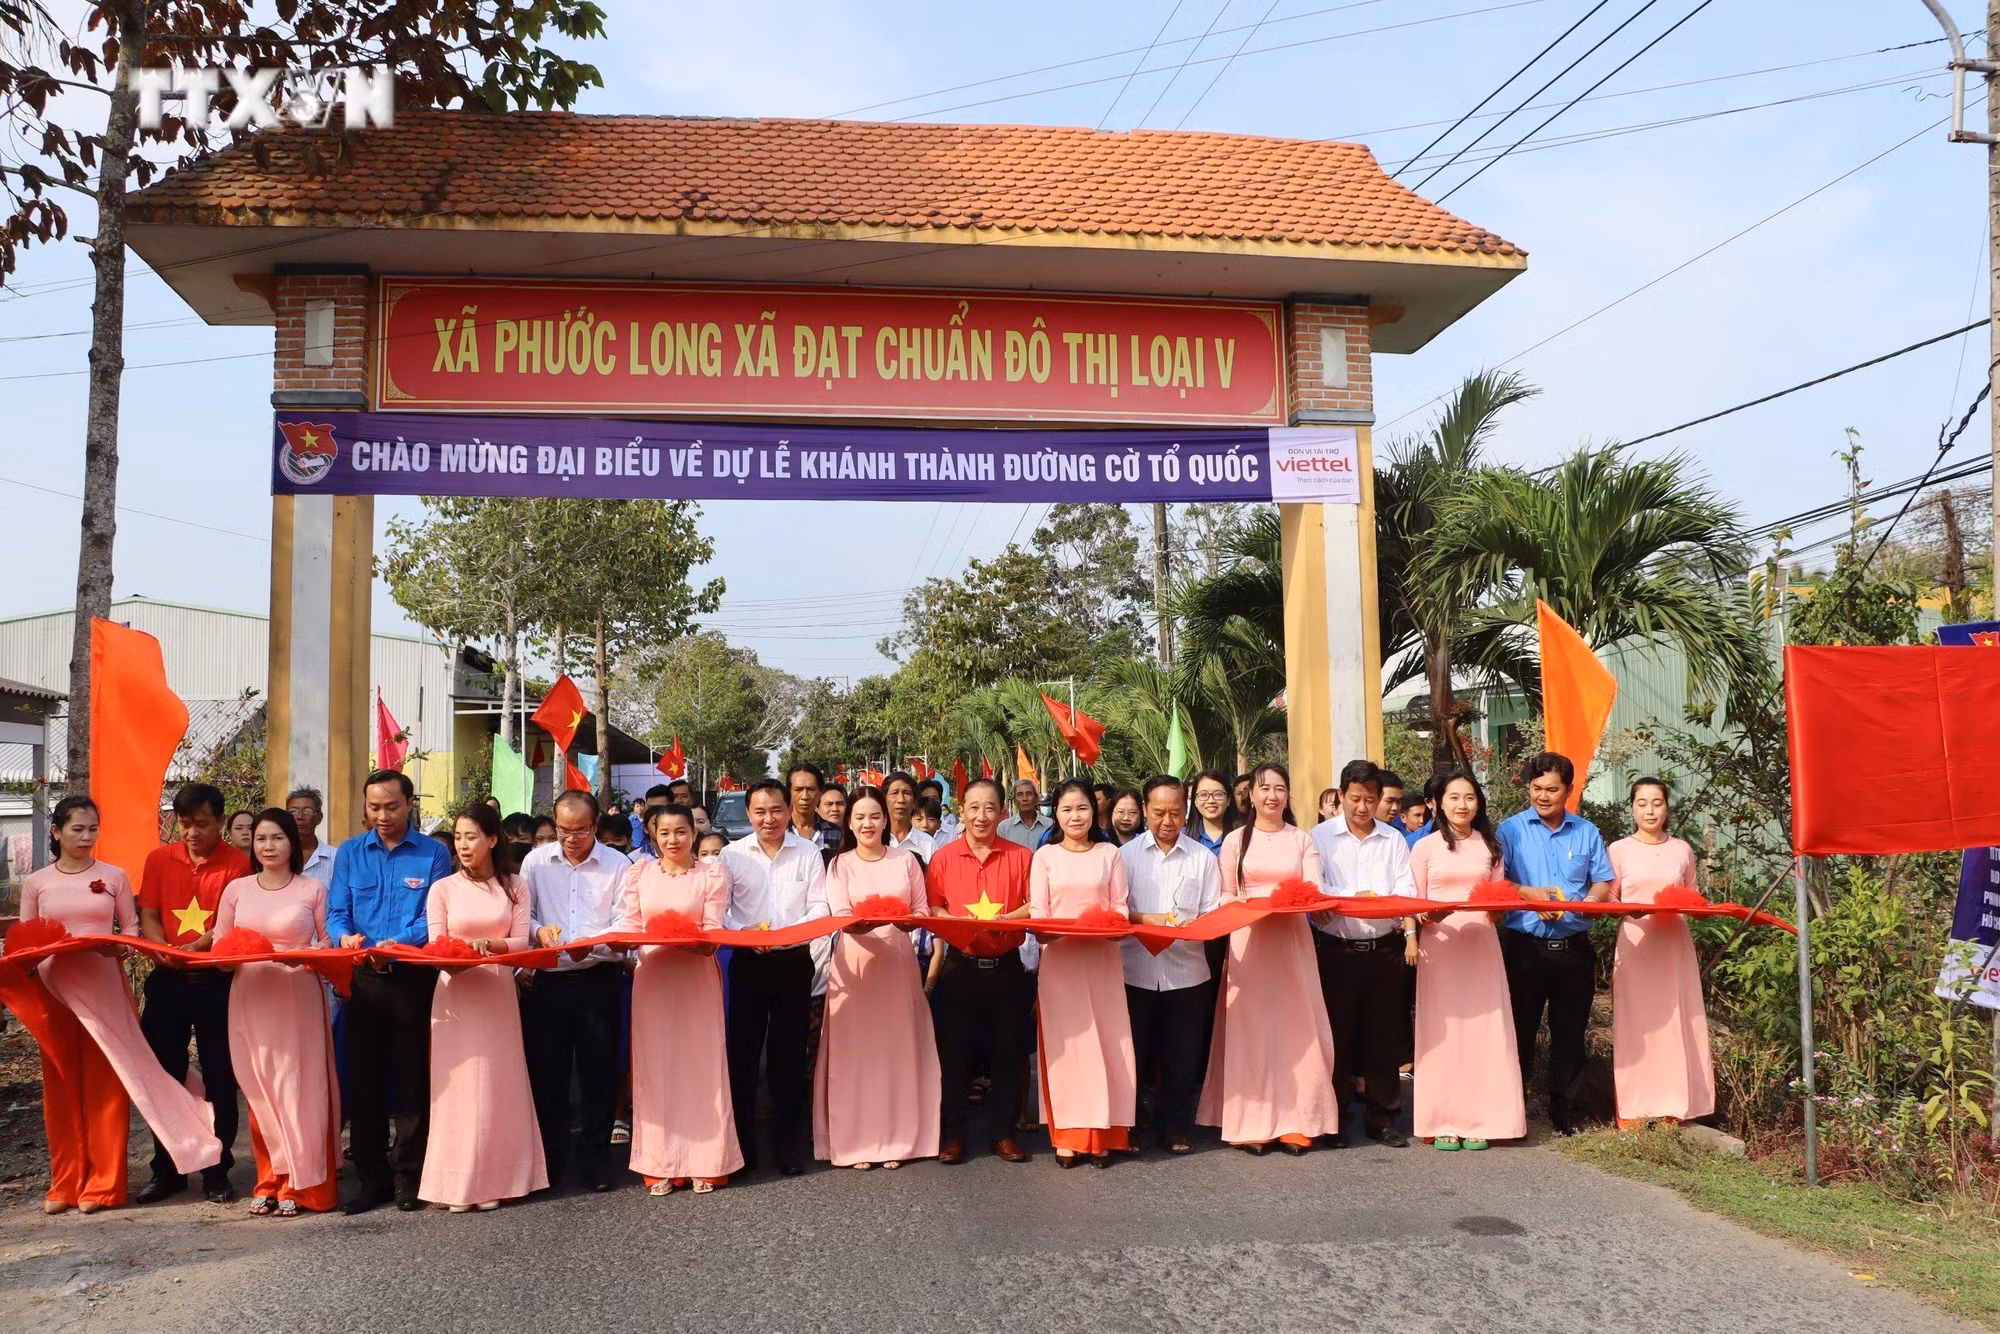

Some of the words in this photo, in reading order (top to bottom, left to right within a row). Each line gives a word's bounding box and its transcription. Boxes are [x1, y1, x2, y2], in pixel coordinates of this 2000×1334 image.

[433, 304, 480, 373] XÃ
[495, 306, 617, 375] PHƯỚC
[629, 321, 722, 377] LONG
[733, 310, 780, 377] XÃ
[792, 325, 863, 390] ĐẠT
[875, 300, 993, 381] CHUẨN
[1004, 317, 1052, 384] ĐÔ
[1062, 332, 1119, 397] THỊ
[1130, 335, 1204, 398] LOẠI
[1215, 338, 1236, 388] V
[352, 436, 430, 472] CHÀO
[440, 438, 528, 474] MỪNG
[536, 446, 585, 482] ĐẠI
[595, 436, 660, 477] BIỂU
[669, 439, 703, 477] VỀ
[713, 447, 754, 484] DỰ
[759, 440, 791, 479] LỄ
[800, 446, 896, 480] KHÁNH
[903, 447, 995, 481] THÀNH
[1003, 447, 1097, 482] ĐƯỜNG
[1104, 446, 1141, 482] CỜ
[1147, 443, 1181, 483] TỔ
[1188, 444, 1259, 486] QUỐC
[1276, 456, 1353, 472] viettel
[1305, 448, 1312, 456] VỊ
